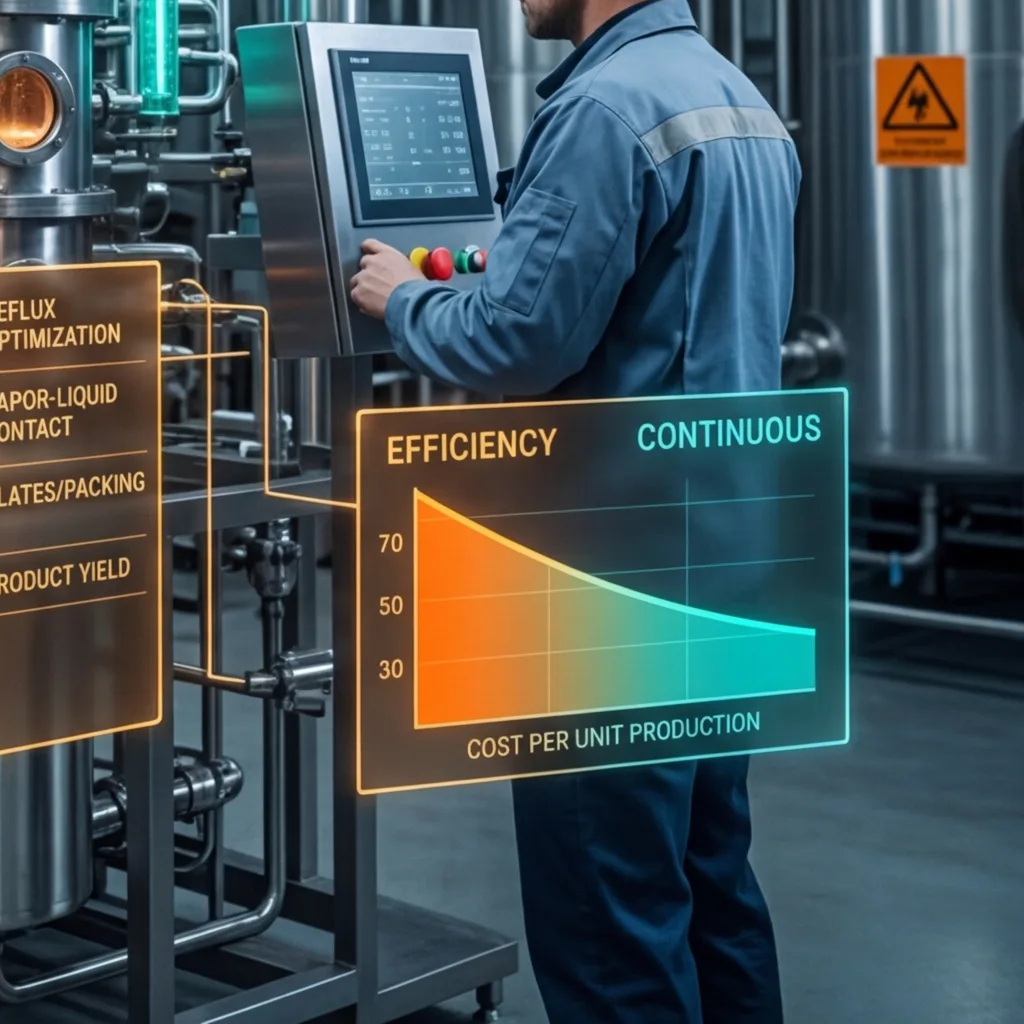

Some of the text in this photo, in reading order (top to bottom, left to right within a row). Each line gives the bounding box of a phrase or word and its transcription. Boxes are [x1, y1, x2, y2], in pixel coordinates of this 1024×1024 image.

[387, 427, 557, 465] EFFICIENCY
[637, 414, 821, 452] CONTINUOUS
[378, 533, 404, 553] 70
[79, 556, 131, 584] YIELD
[378, 595, 404, 616] 50
[378, 659, 404, 679] 30
[467, 711, 761, 760] COST PER UNIT PRODUCTION
